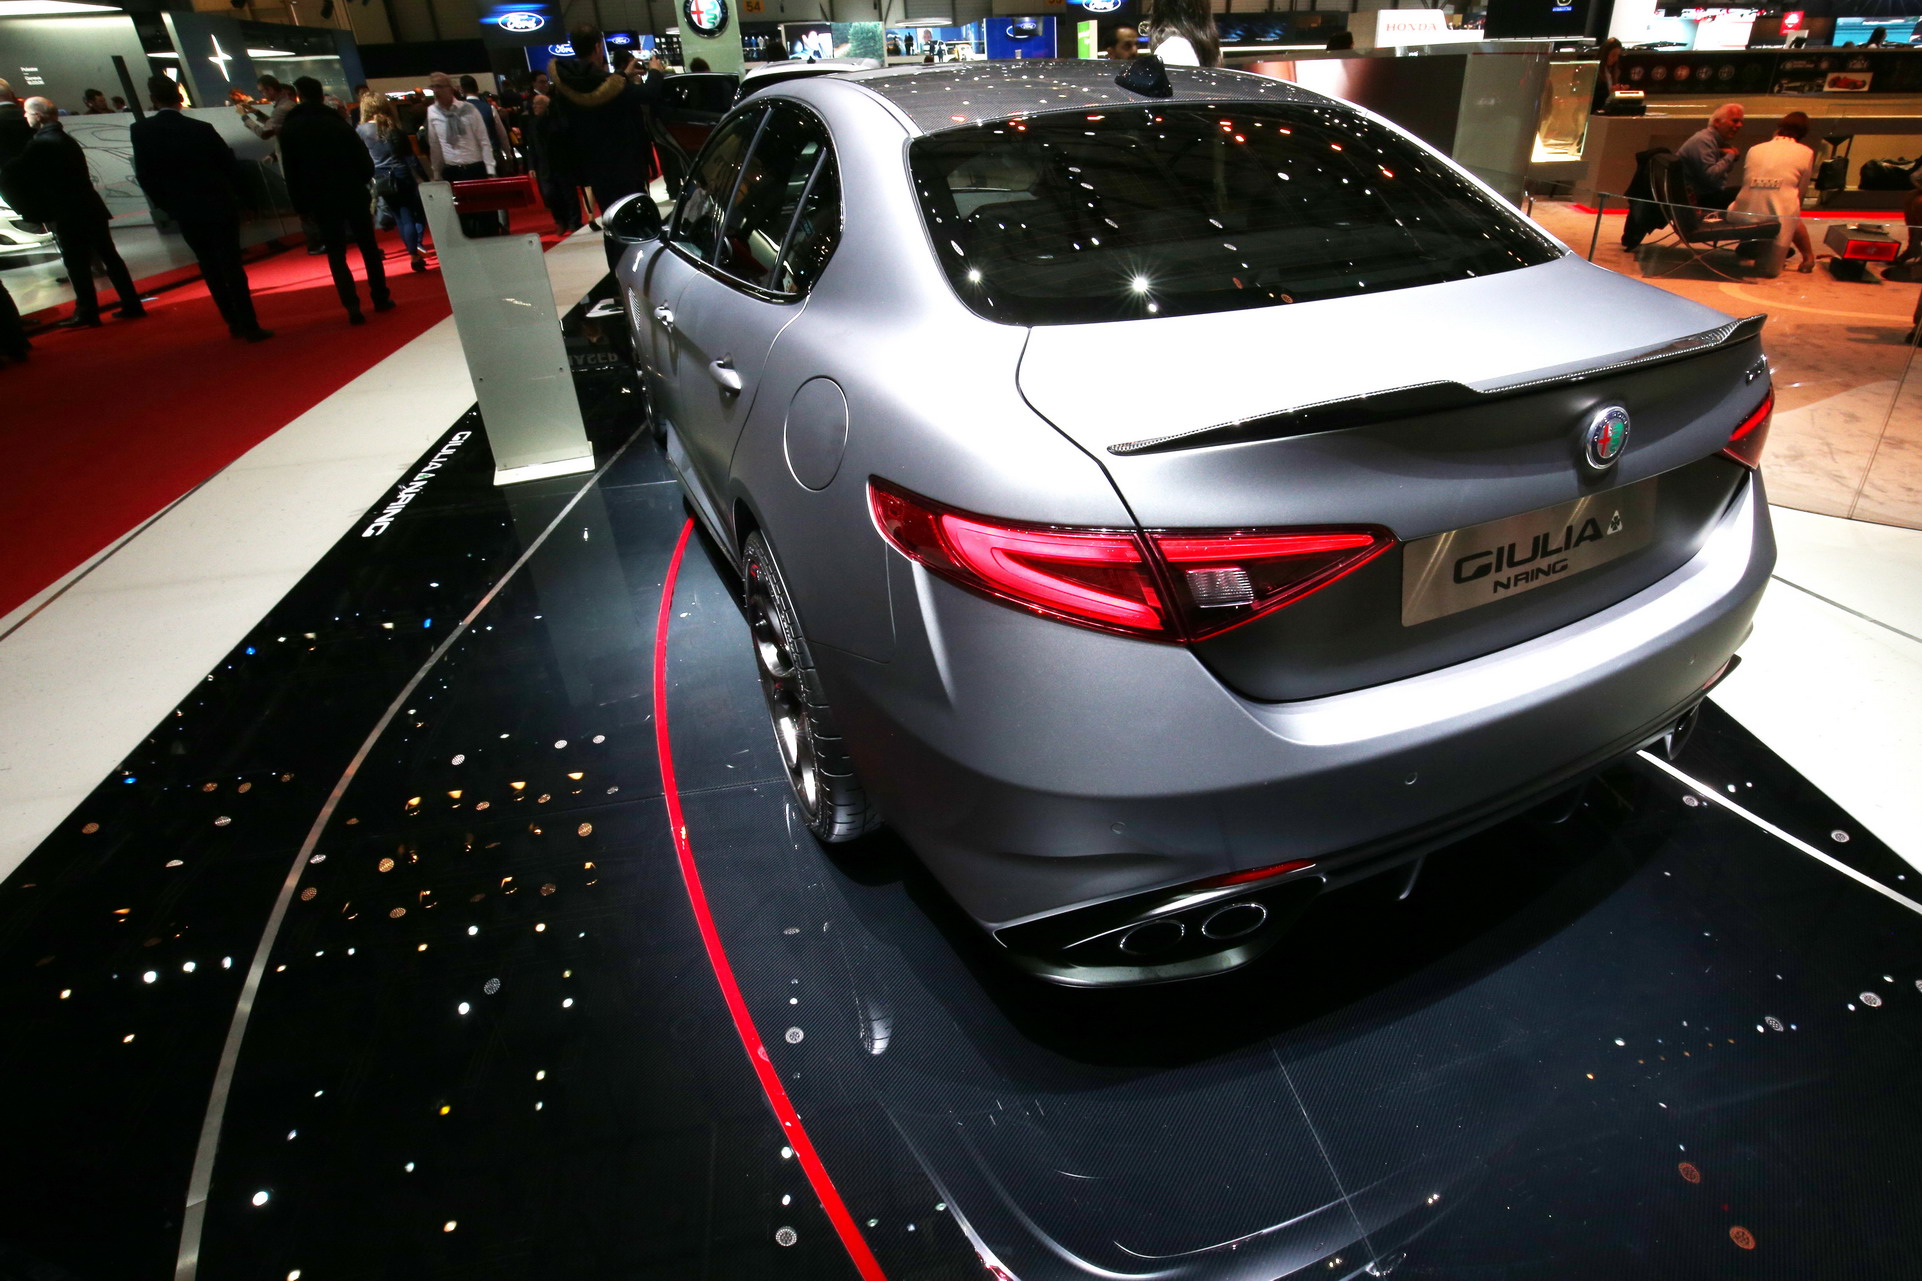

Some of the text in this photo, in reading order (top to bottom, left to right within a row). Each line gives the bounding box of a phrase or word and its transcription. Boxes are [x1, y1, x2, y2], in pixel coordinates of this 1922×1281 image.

[746, 1, 761, 12] 54
[1386, 23, 1437, 32] HONDA
[421, 431, 472, 472] GIULIA
[1453, 517, 1603, 584] GIULIA
